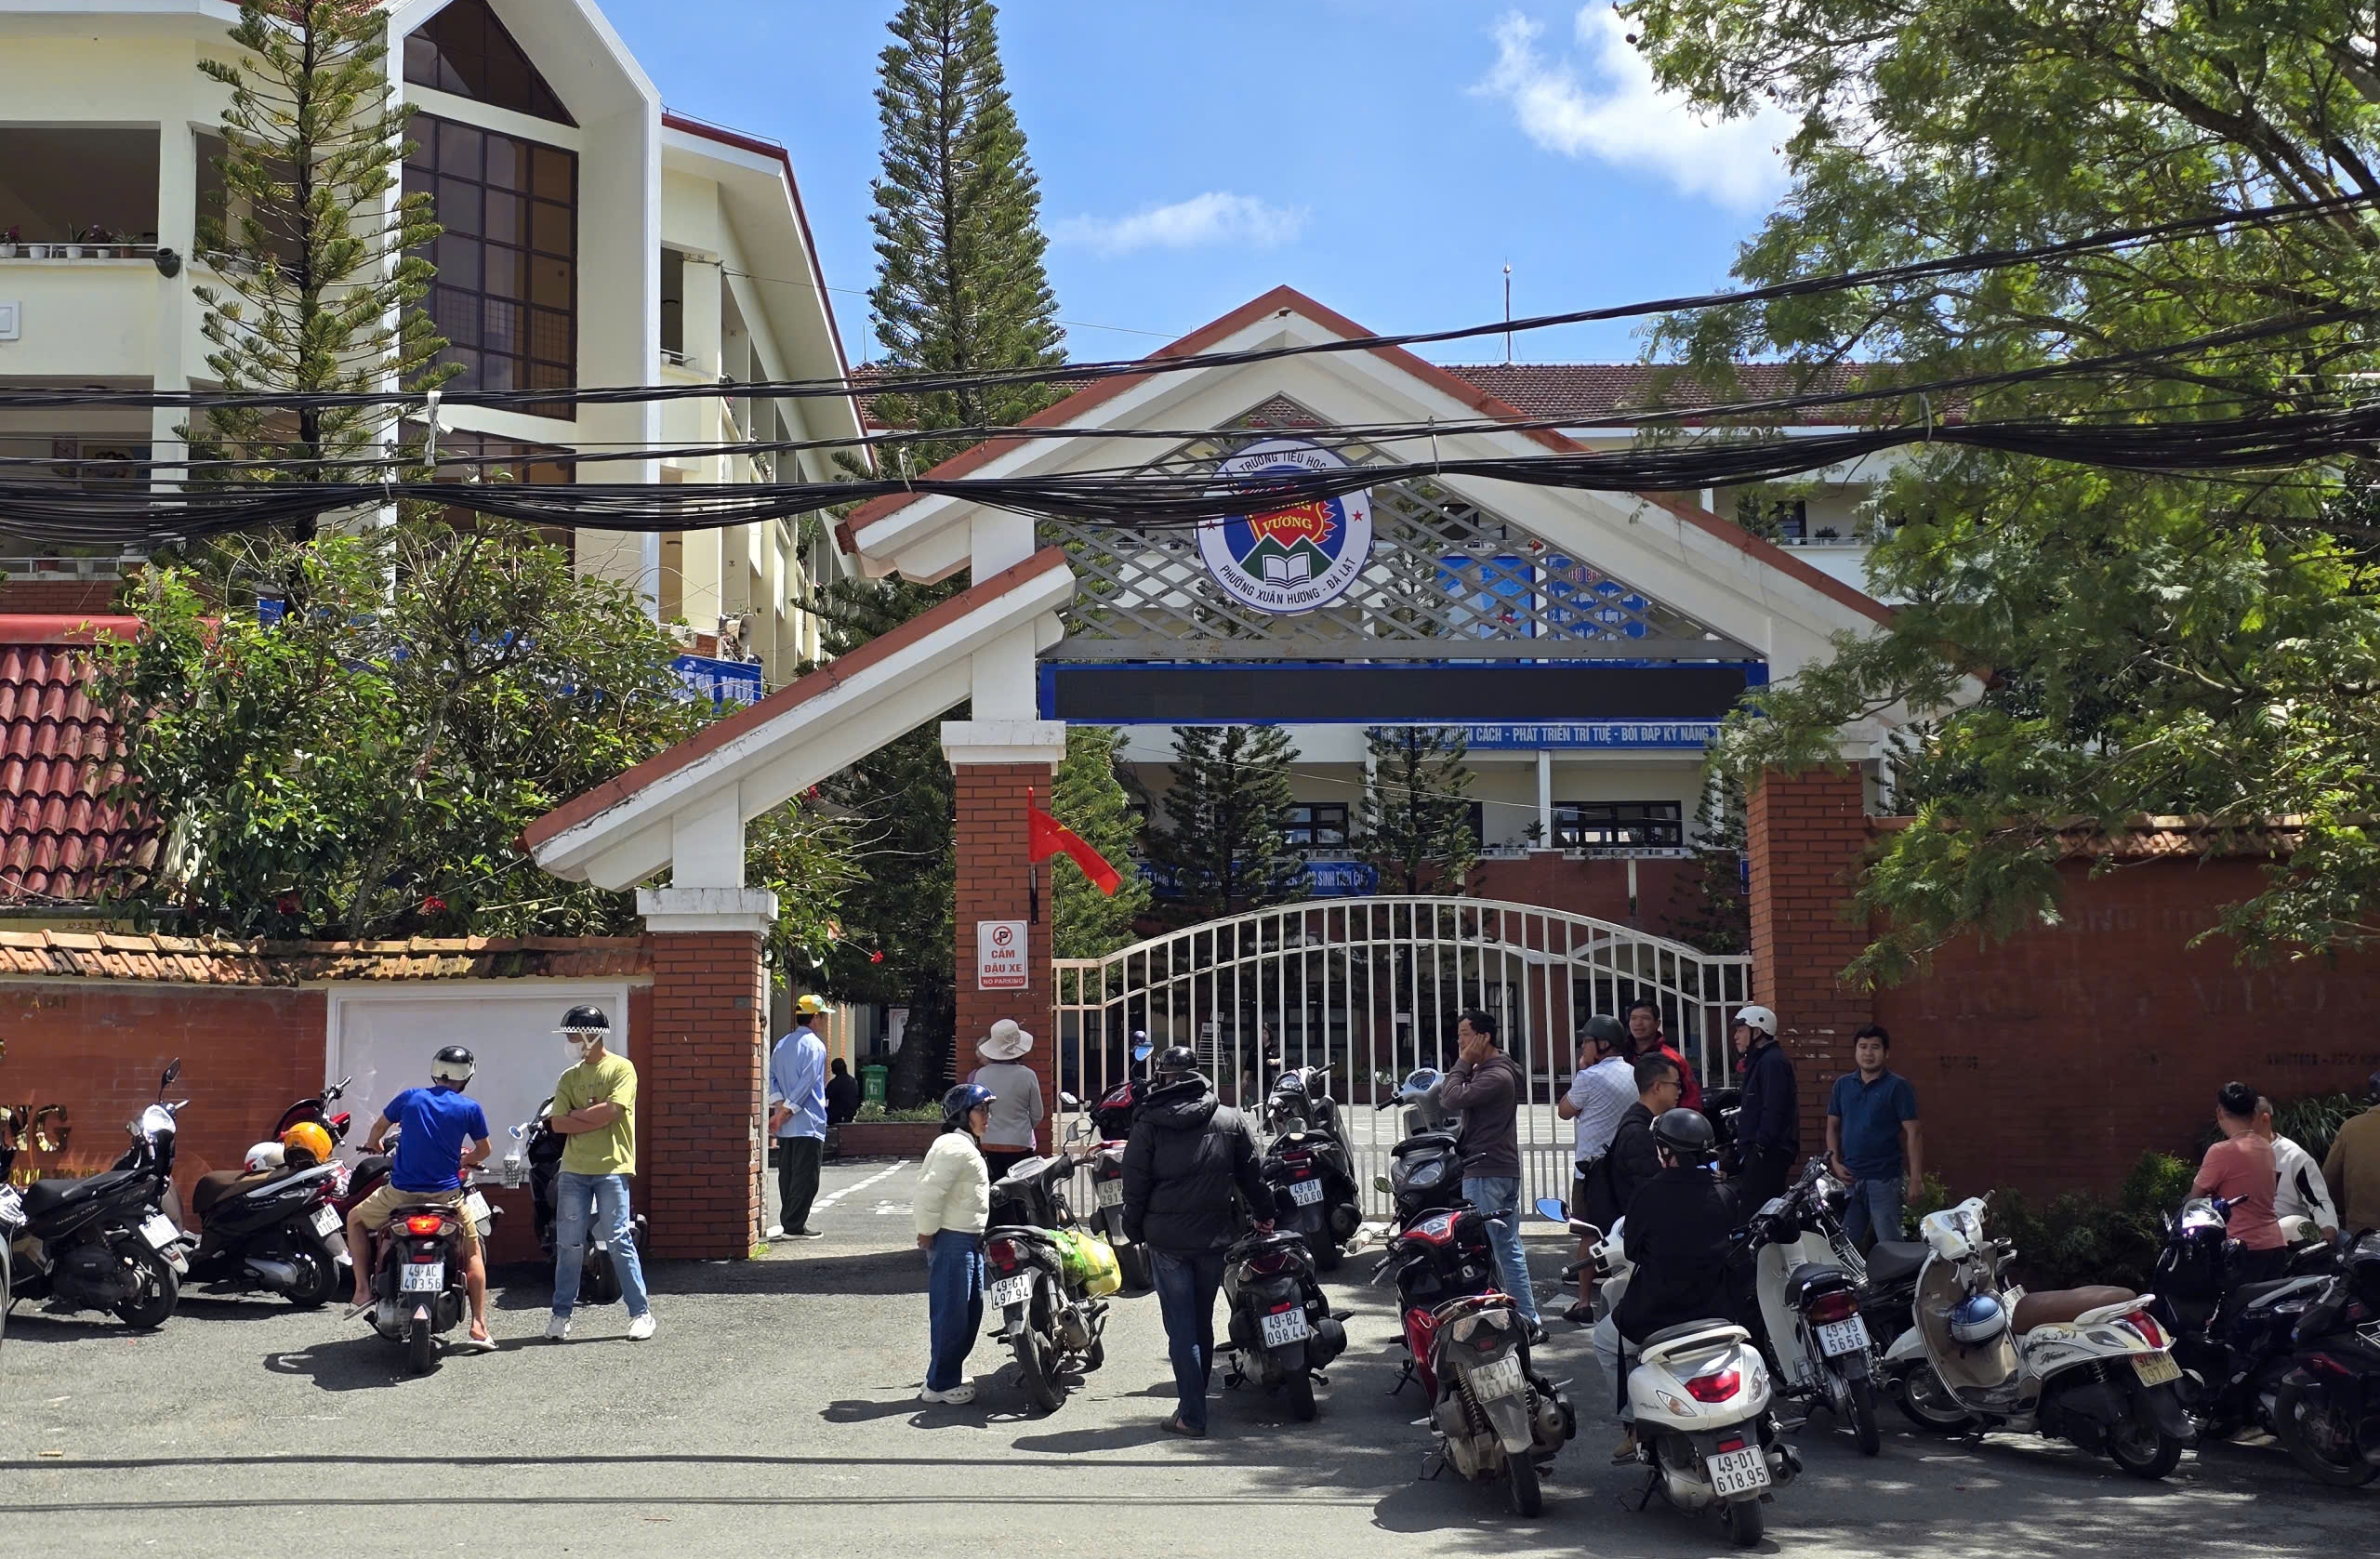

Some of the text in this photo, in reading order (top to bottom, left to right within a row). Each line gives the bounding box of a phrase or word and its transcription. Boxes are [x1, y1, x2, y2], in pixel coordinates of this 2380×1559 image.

[1219, 564, 1254, 597] PHƯỜNG
[1256, 589, 1284, 604] XUÂN
[1327, 574, 1342, 590] ĐÀ
[1342, 557, 1357, 578] LẠT
[1476, 723, 1501, 743] CÁCH
[1513, 723, 1538, 743] PHÁT
[1317, 871, 1335, 887] SINH
[991, 946, 1015, 958] CẤM
[984, 962, 1023, 974] ĐẬU XE
[1104, 1182, 1122, 1194] 49-B
[1294, 1181, 1316, 1194] 49-B1
[408, 1265, 438, 1277] 49-AC
[403, 1278, 442, 1290] 403.56
[996, 1275, 1024, 1293] 49-G1
[994, 1287, 1029, 1307] 497.94
[1269, 1311, 1300, 1329] 49-B2
[1825, 1319, 1858, 1339] 49-V9
[1267, 1324, 1306, 1345] 098.44
[1828, 1333, 1863, 1353] 5656
[1716, 1450, 1756, 1473] 49-D1
[1716, 1466, 1767, 1493] 618.95
